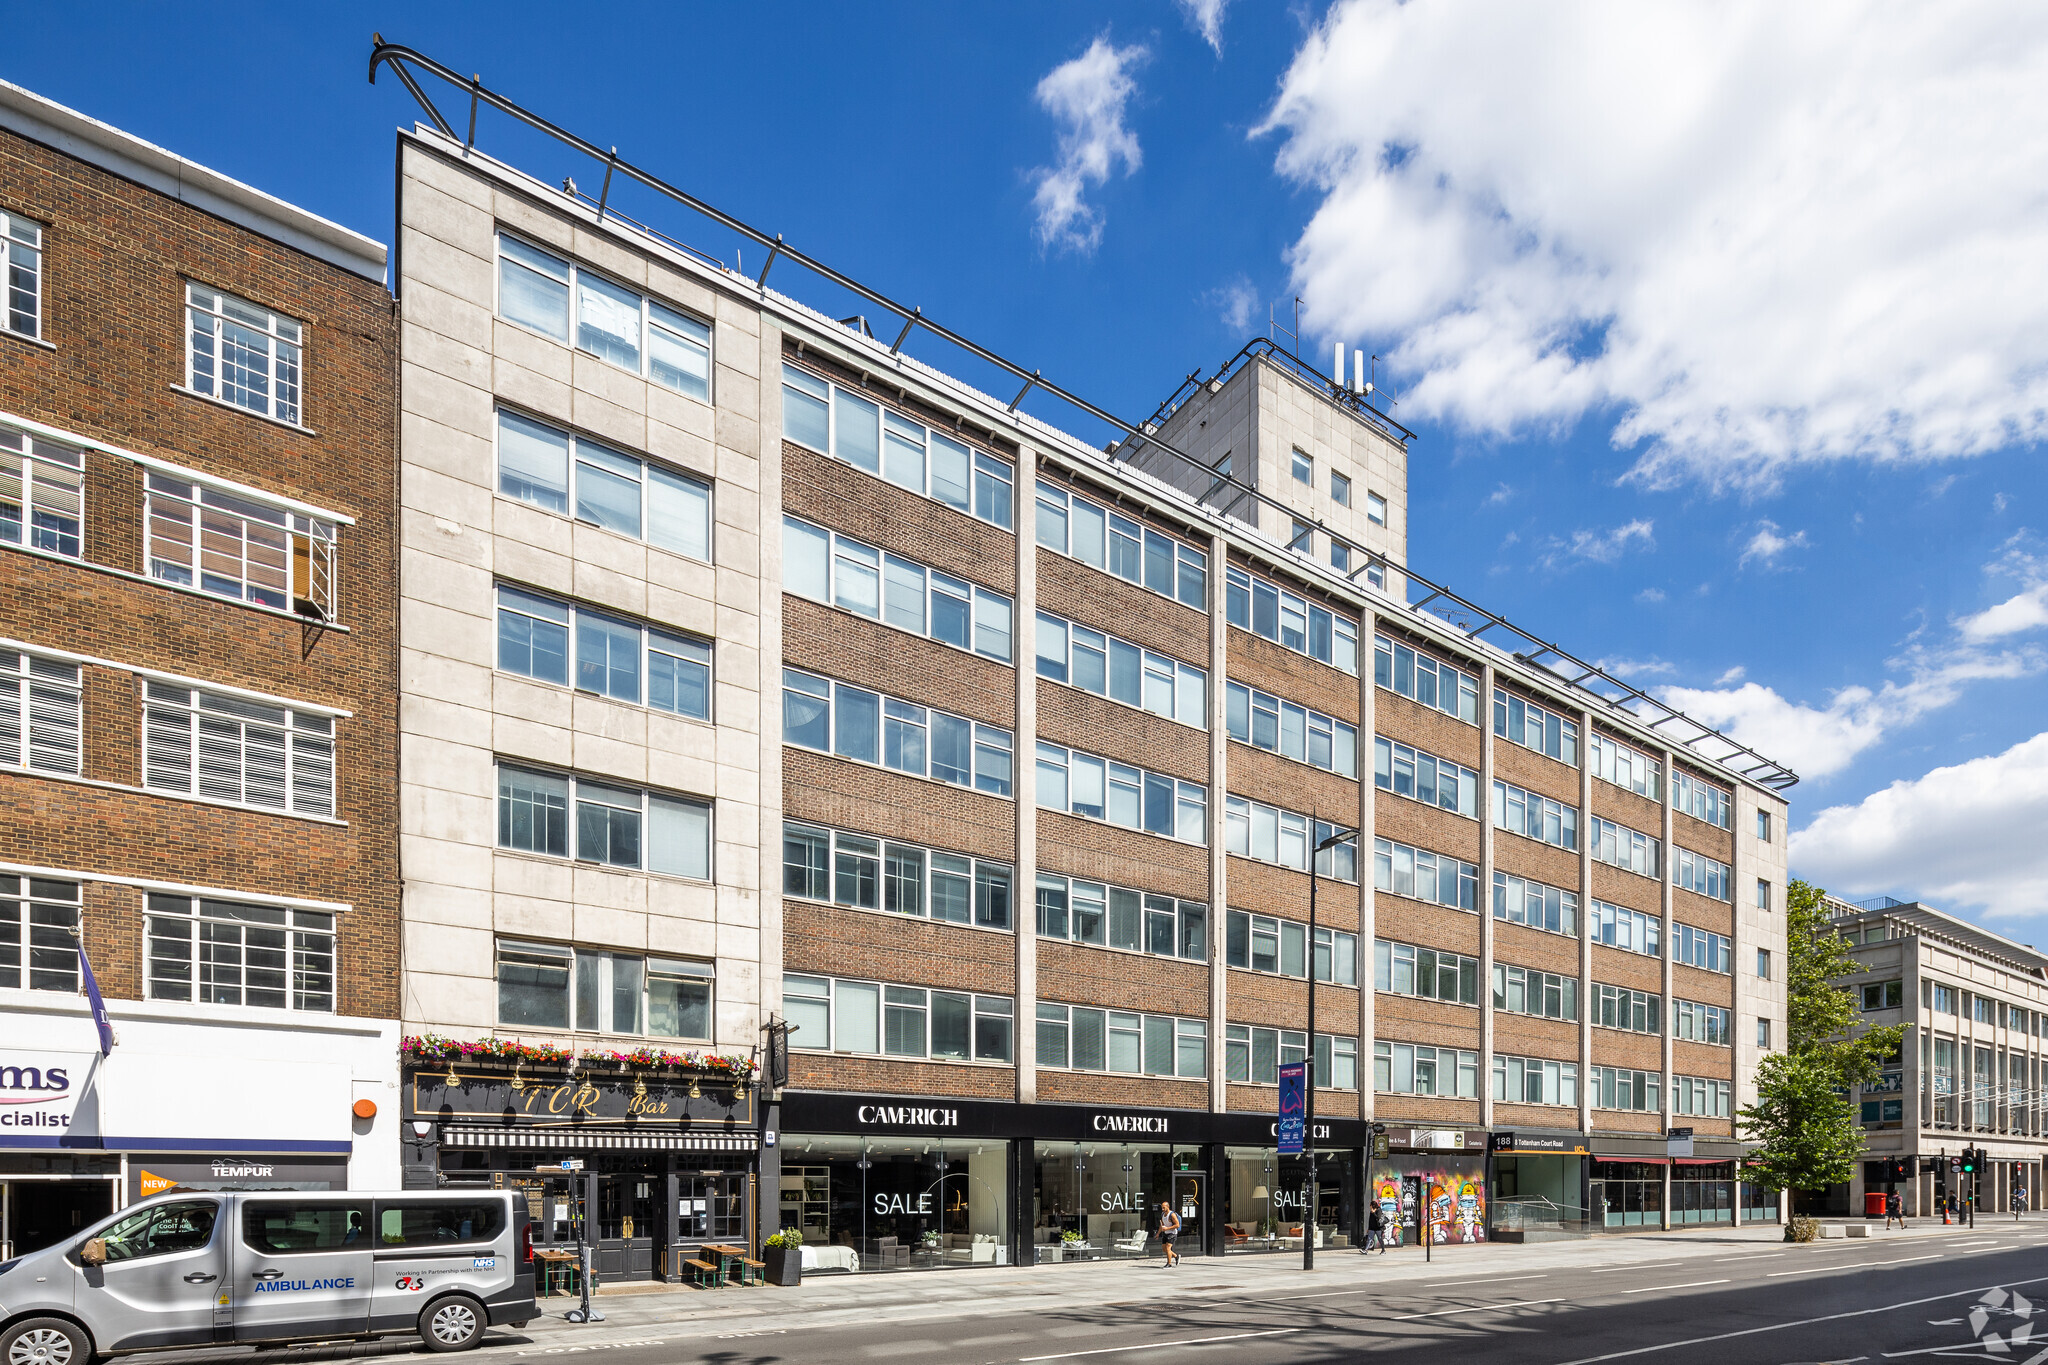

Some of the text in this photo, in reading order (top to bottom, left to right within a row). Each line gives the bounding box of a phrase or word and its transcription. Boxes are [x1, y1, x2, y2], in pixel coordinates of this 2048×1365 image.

[520, 1085, 669, 1116] TCR Bar
[858, 1106, 958, 1126] CAMERICH
[1093, 1115, 1168, 1133] CAMERICH
[1496, 1137, 1511, 1145] 188
[211, 1167, 273, 1177] TEMPUR
[143, 1180, 168, 1188] NEW
[874, 1193, 933, 1215] SALE
[1101, 1191, 1145, 1211] SALE
[474, 1259, 495, 1267] NHS
[255, 1277, 355, 1292] AMBULANCE
[395, 1277, 424, 1291] G4S
[514, 1340, 665, 1356] LOADING
